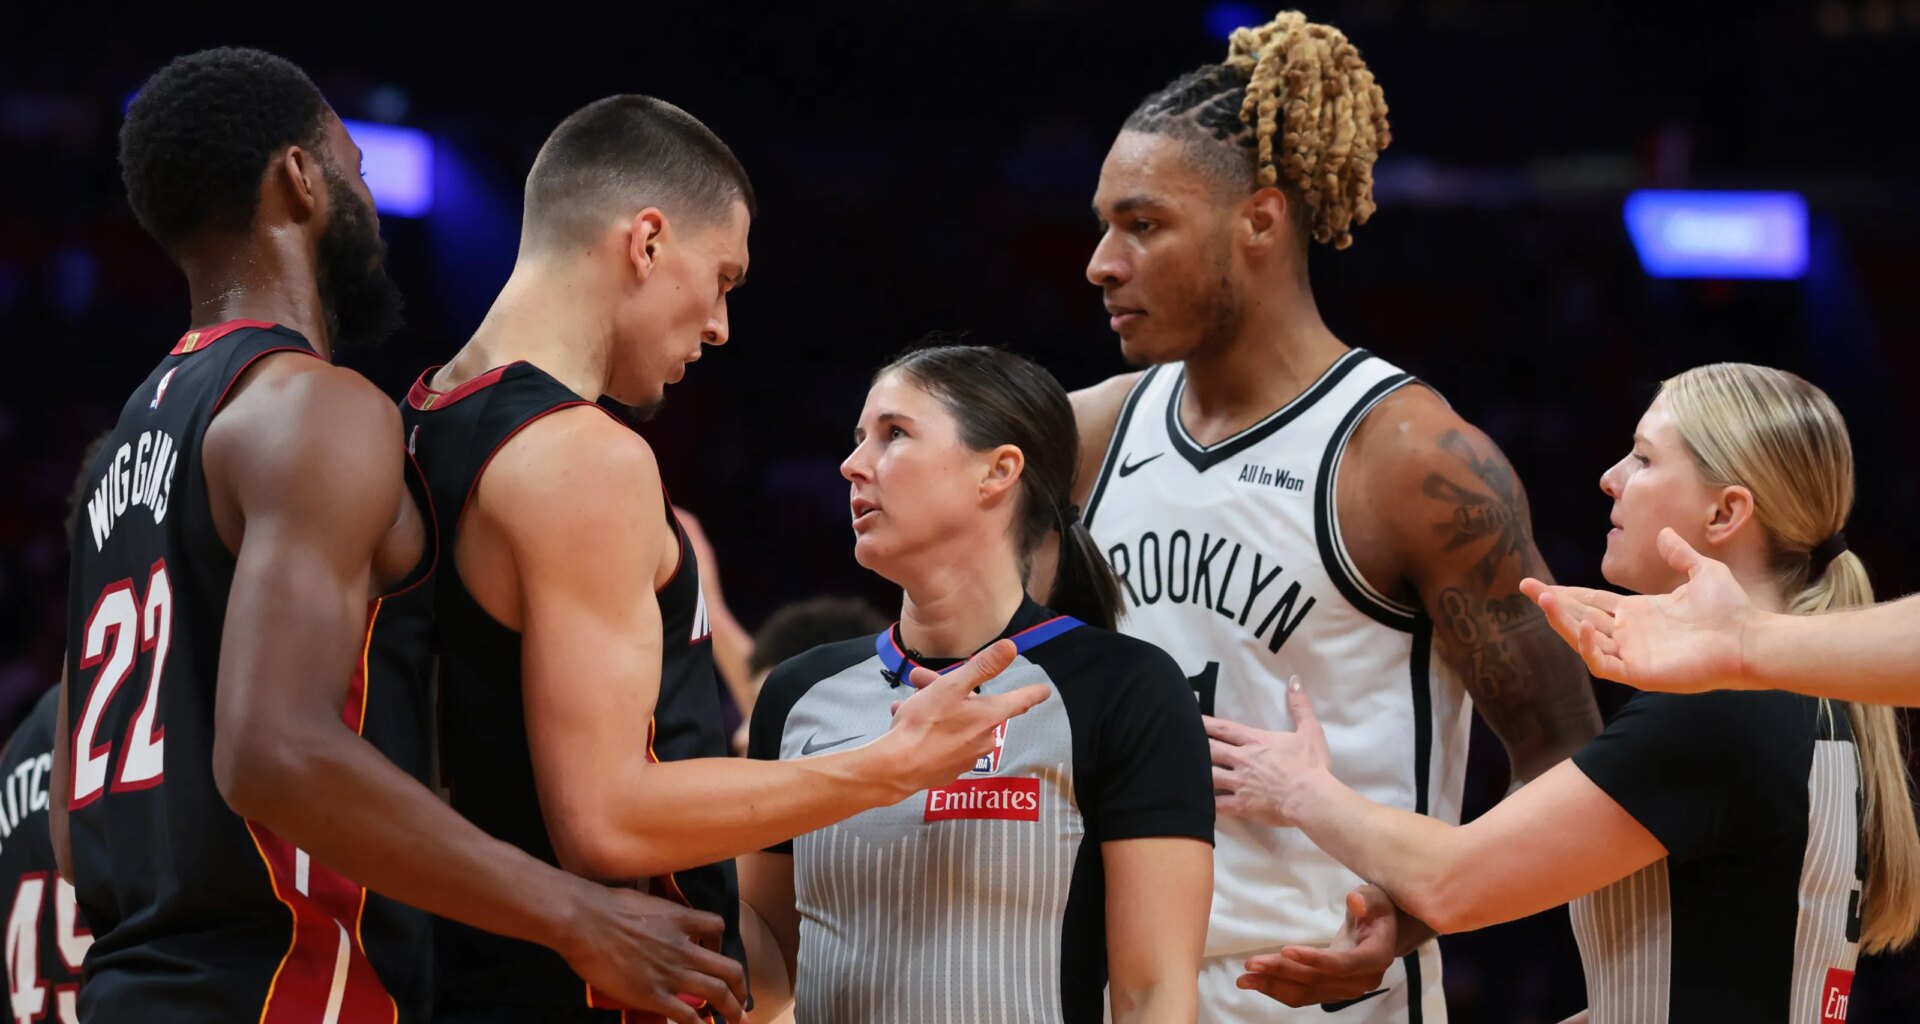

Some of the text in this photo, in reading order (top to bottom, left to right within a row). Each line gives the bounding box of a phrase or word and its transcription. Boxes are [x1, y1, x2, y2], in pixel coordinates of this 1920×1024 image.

[87, 430, 178, 553] WIGGINS
[1238, 464, 1305, 491] All In Won
[1108, 529, 1317, 655] ROOKLYN
[68, 557, 173, 811] 22
[0, 749, 55, 856] ITC
[929, 786, 1037, 812] Emirates
